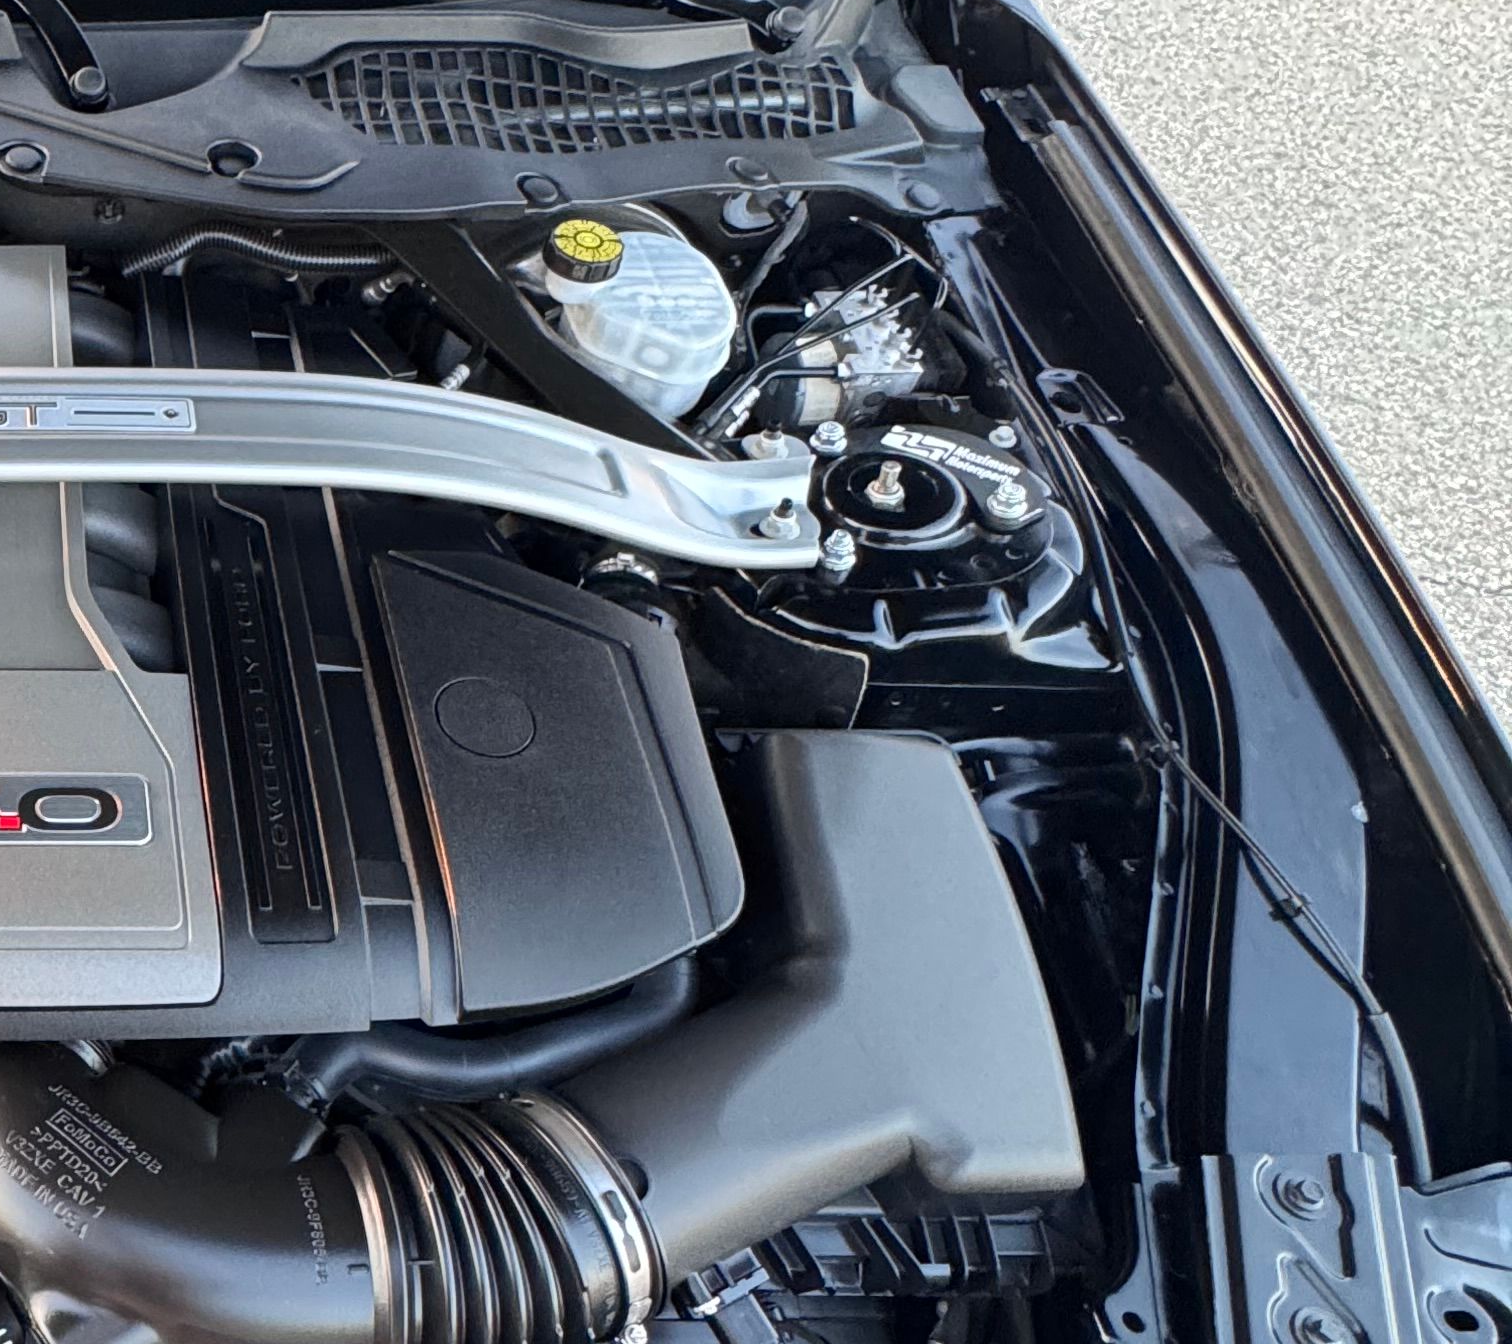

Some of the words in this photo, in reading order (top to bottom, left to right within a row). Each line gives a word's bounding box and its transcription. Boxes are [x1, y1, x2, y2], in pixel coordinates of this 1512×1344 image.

[953, 446, 1021, 477] Maximum
[54, 1114, 117, 1168] FoMoCo
[57, 1174, 95, 1206] CAV
[34, 1184, 56, 1205] IN
[53, 1201, 89, 1240] USA
